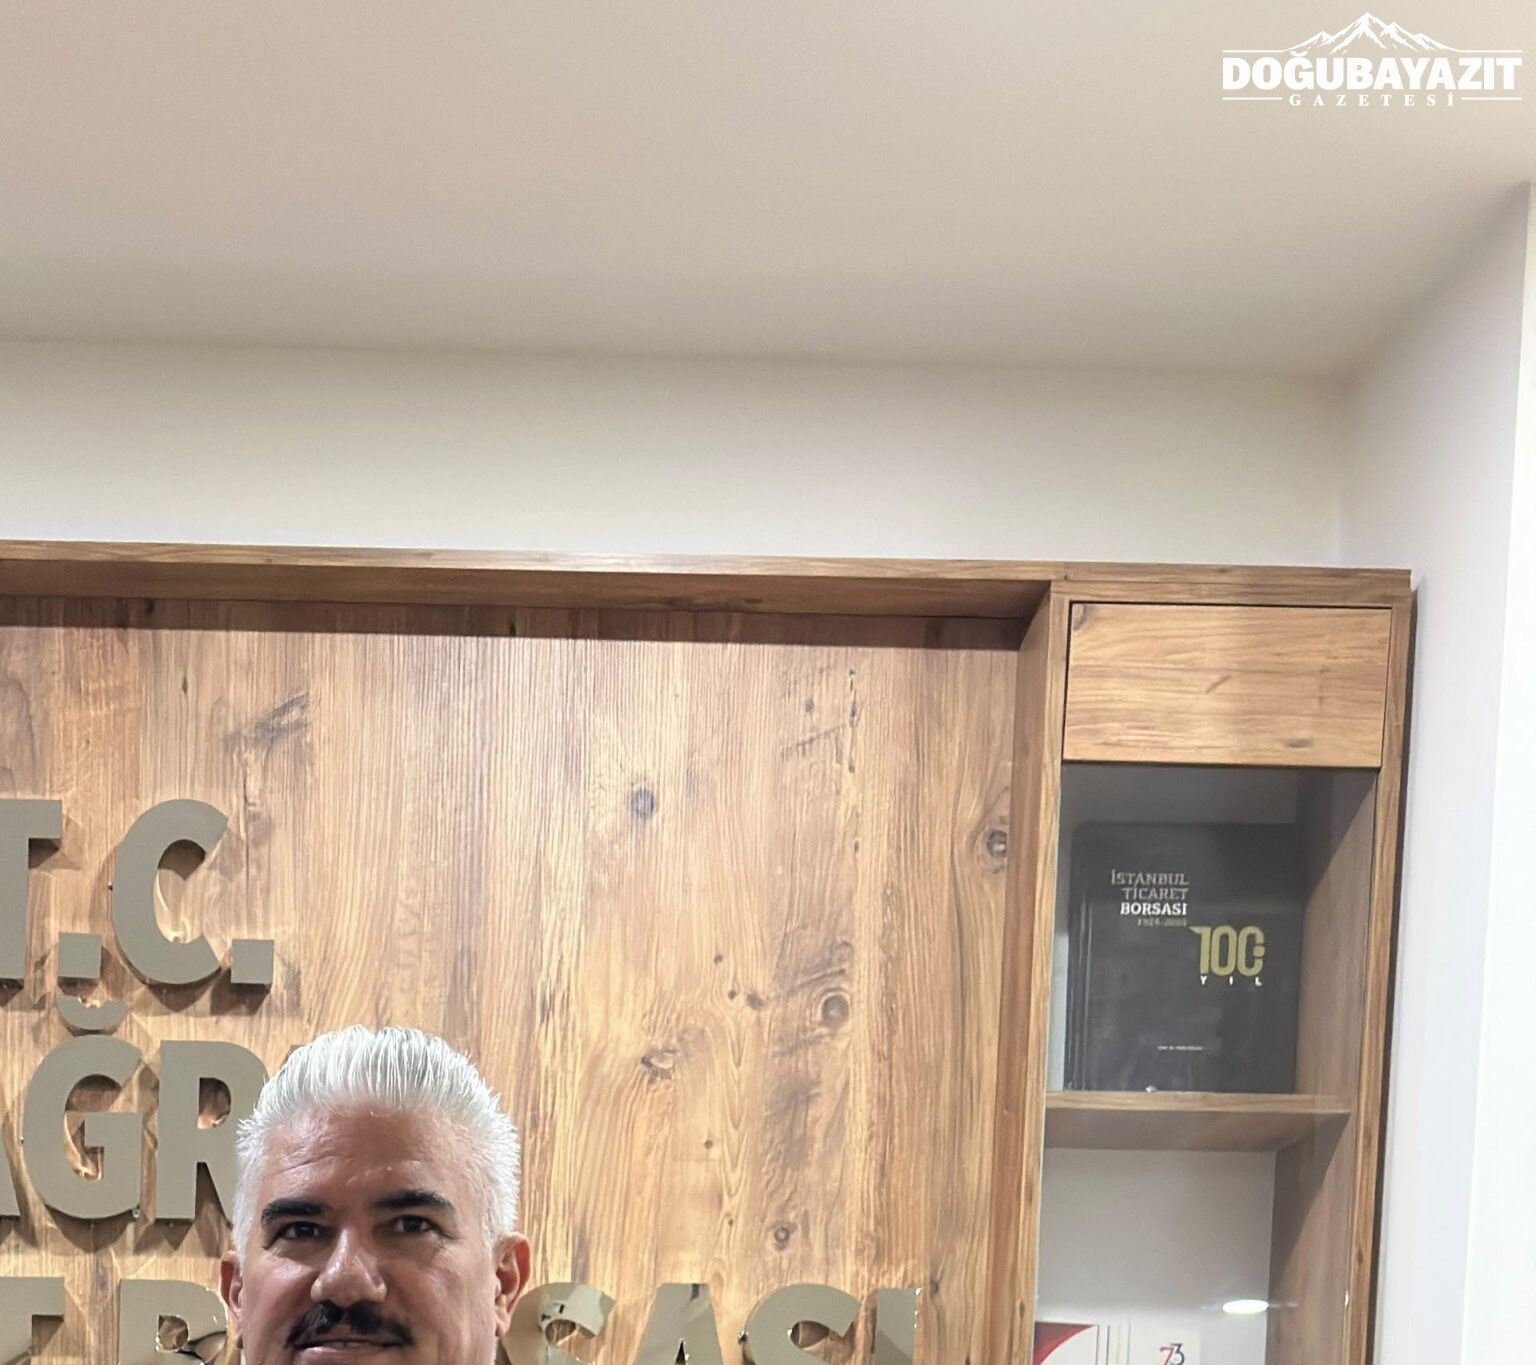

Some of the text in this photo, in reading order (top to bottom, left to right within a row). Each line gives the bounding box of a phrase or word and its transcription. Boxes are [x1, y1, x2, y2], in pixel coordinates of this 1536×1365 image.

[1111, 869, 1190, 886] İSTANBUL
[1120, 886, 1190, 900] TİCARET
[1120, 902, 1188, 916] BORSASI
[1189, 925, 1266, 977] 100
[1199, 975, 1263, 987] YIL
